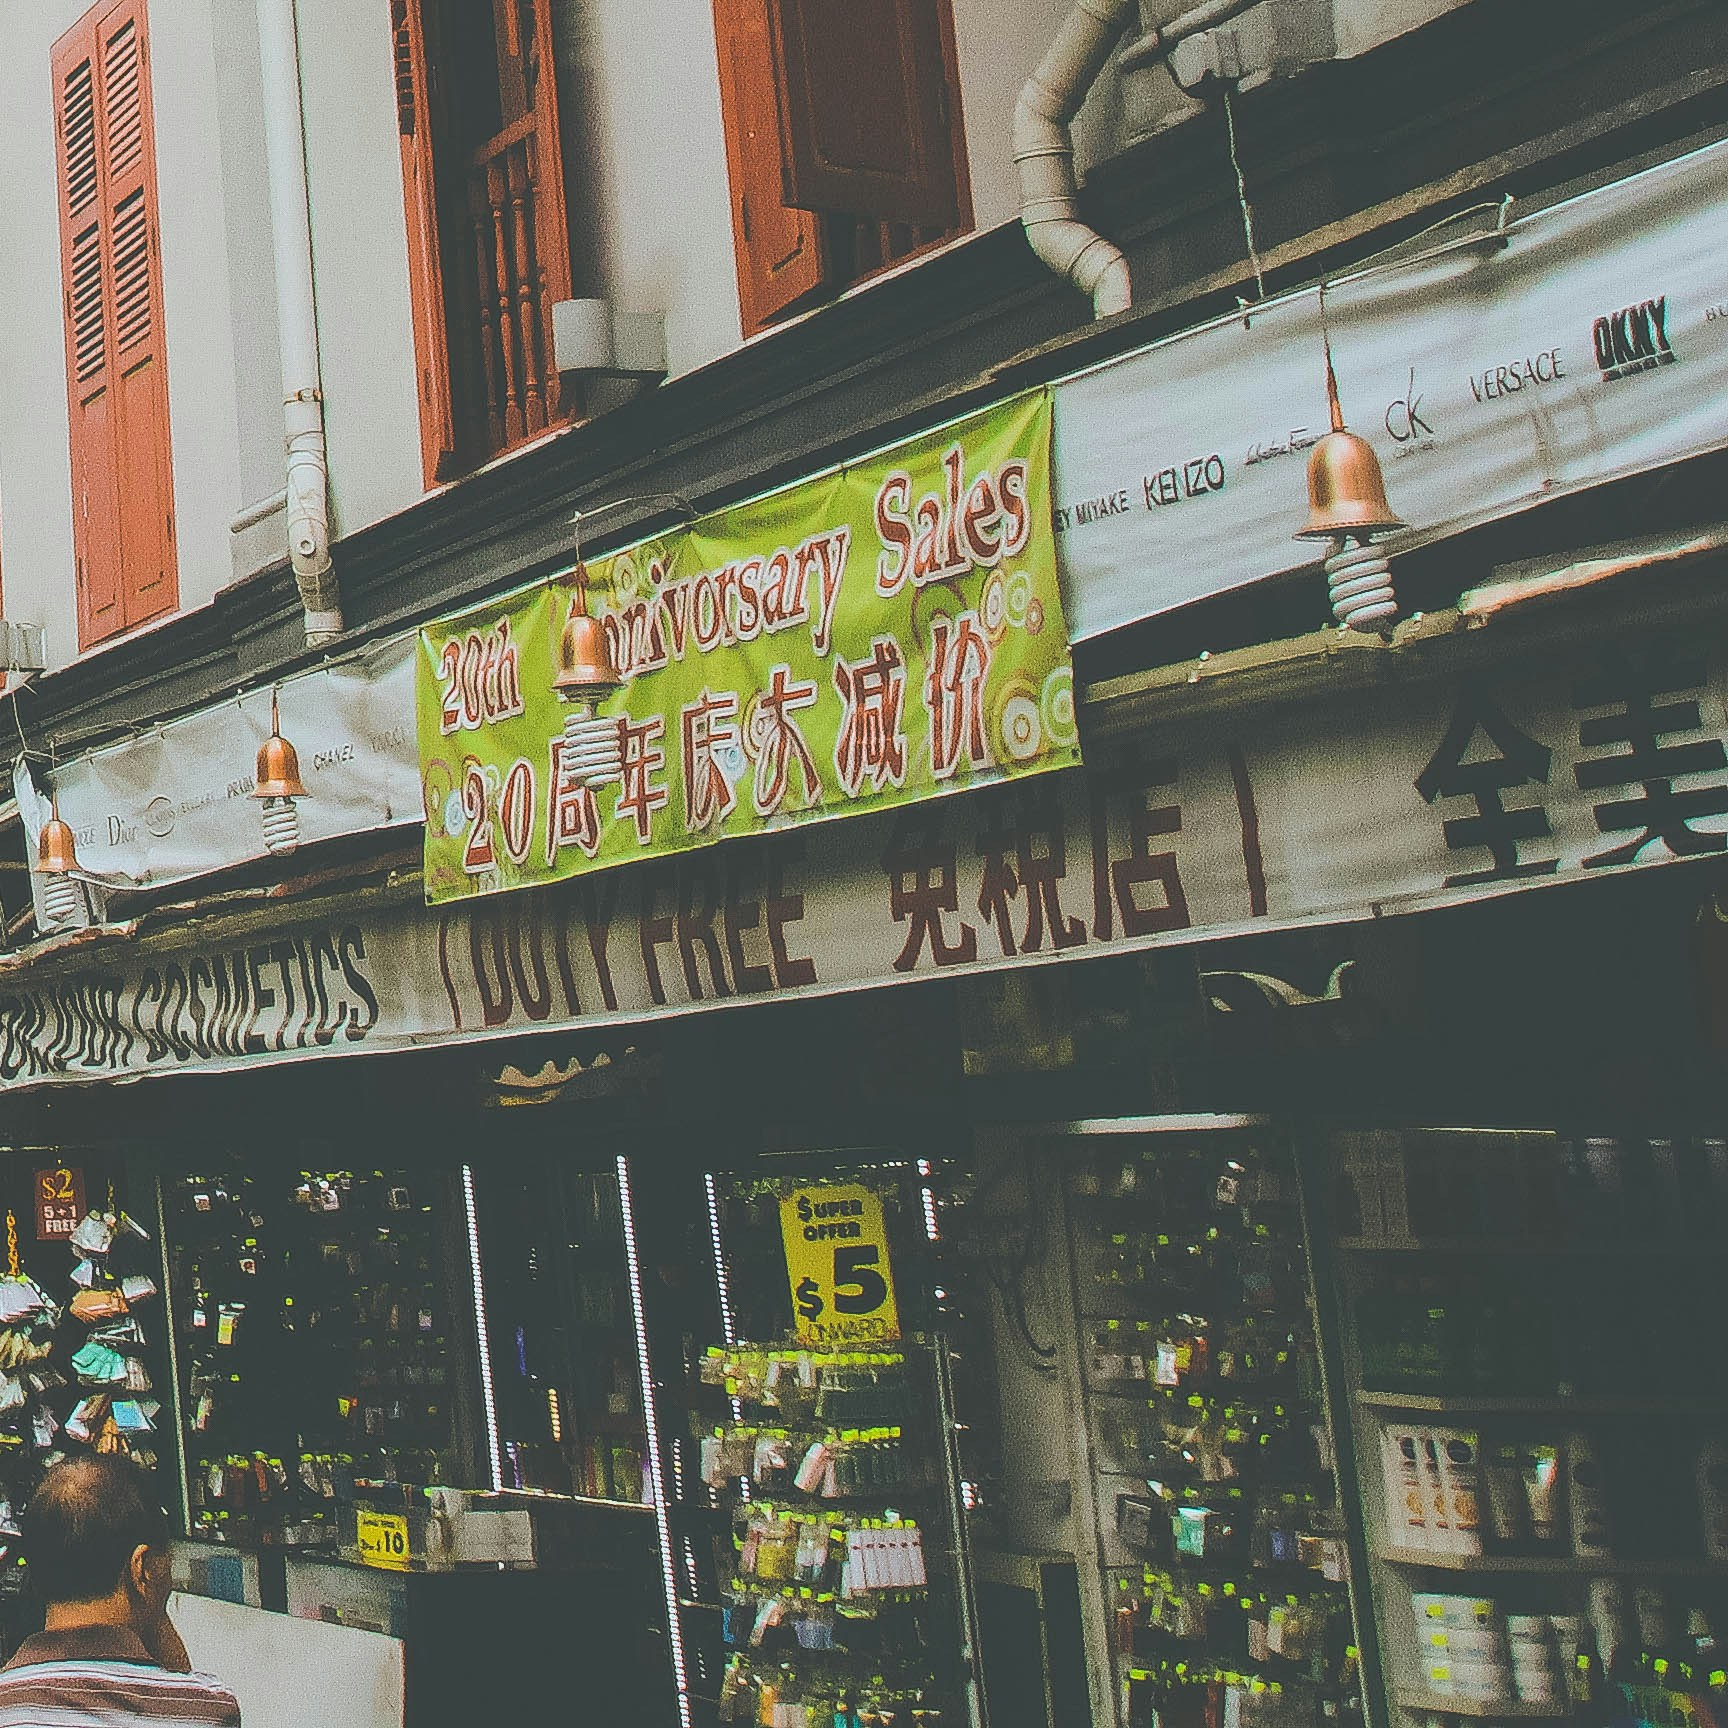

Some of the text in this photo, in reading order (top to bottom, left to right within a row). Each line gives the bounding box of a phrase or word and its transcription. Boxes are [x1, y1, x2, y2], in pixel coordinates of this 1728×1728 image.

[1469, 348, 1567, 404] VERSACE
[1592, 294, 1673, 371] DKNY
[440, 615, 524, 734] 20th
[873, 440, 1031, 598] Sales
[468, 834, 820, 1025] DUTY FREE
[131, 924, 382, 1063] COSMETICS
[45, 1218, 77, 1233] FREE
[803, 1221, 862, 1242] OFFER
